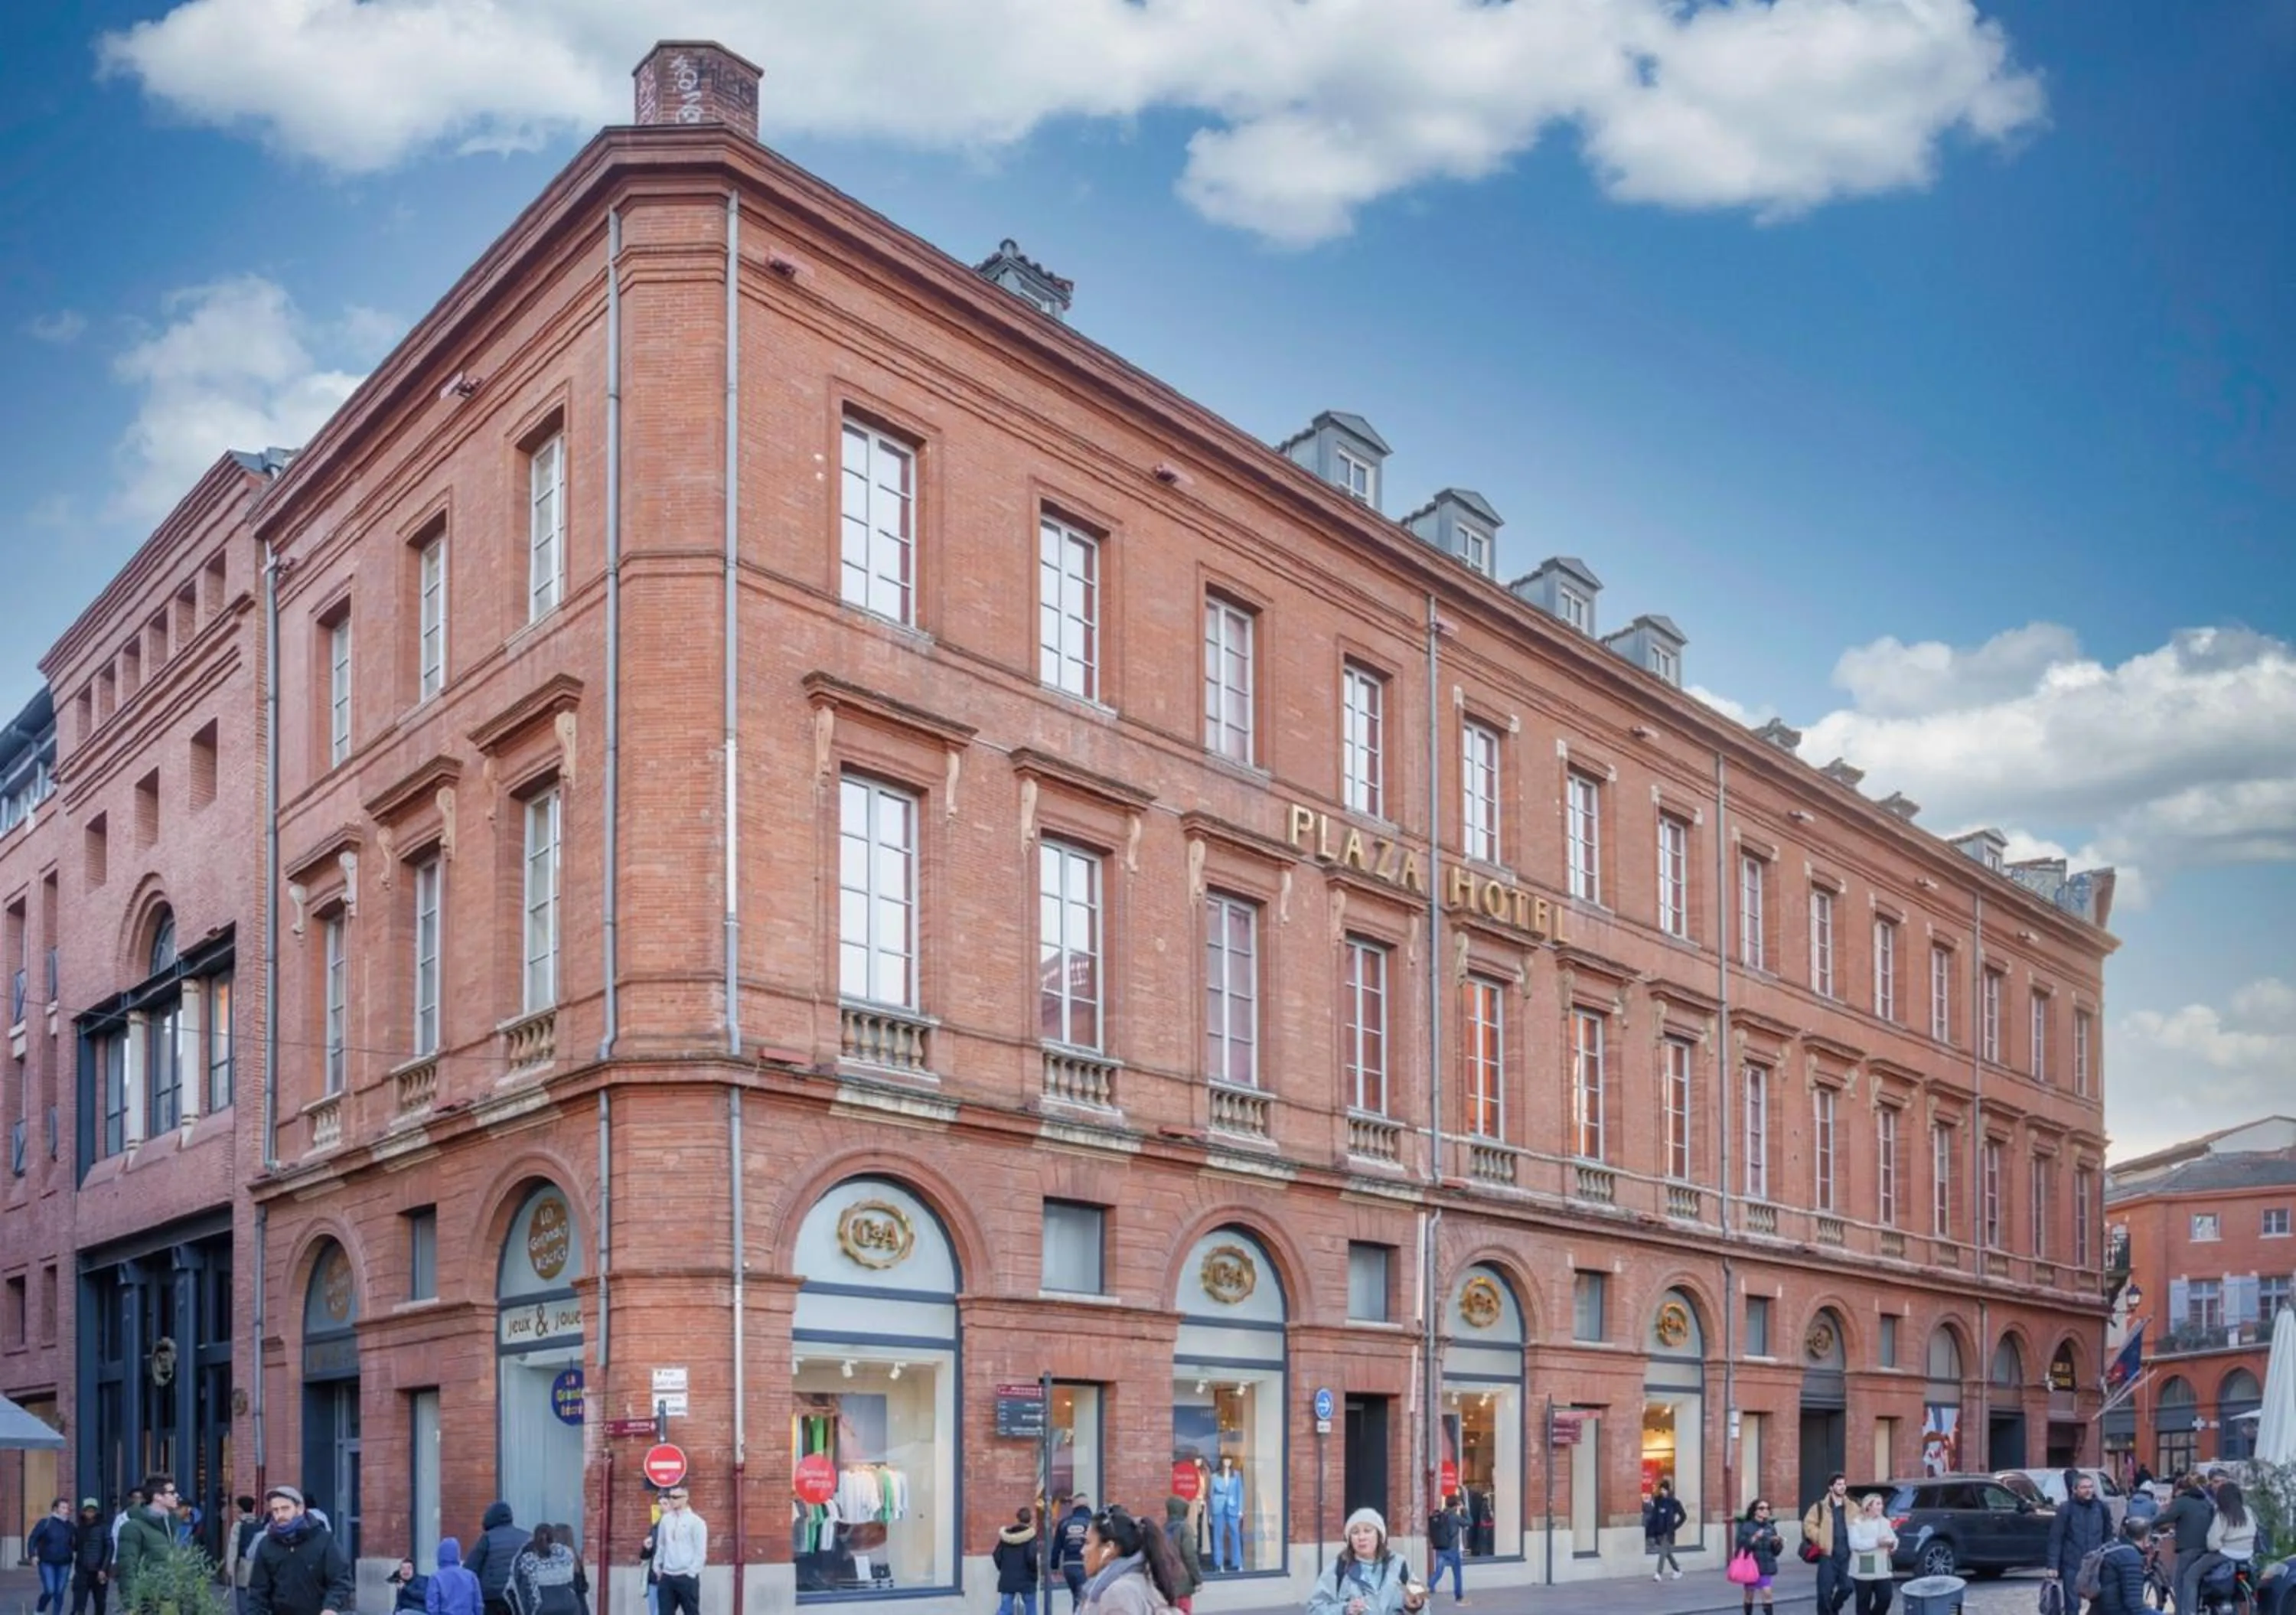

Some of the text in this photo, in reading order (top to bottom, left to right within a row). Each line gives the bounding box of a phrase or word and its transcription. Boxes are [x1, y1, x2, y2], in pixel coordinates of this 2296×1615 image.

[1289, 803, 1570, 945] PLAZA HOTEL
[852, 1218, 899, 1251] C&A
[507, 1315, 532, 1338] jeux
[536, 1303, 549, 1337] &
